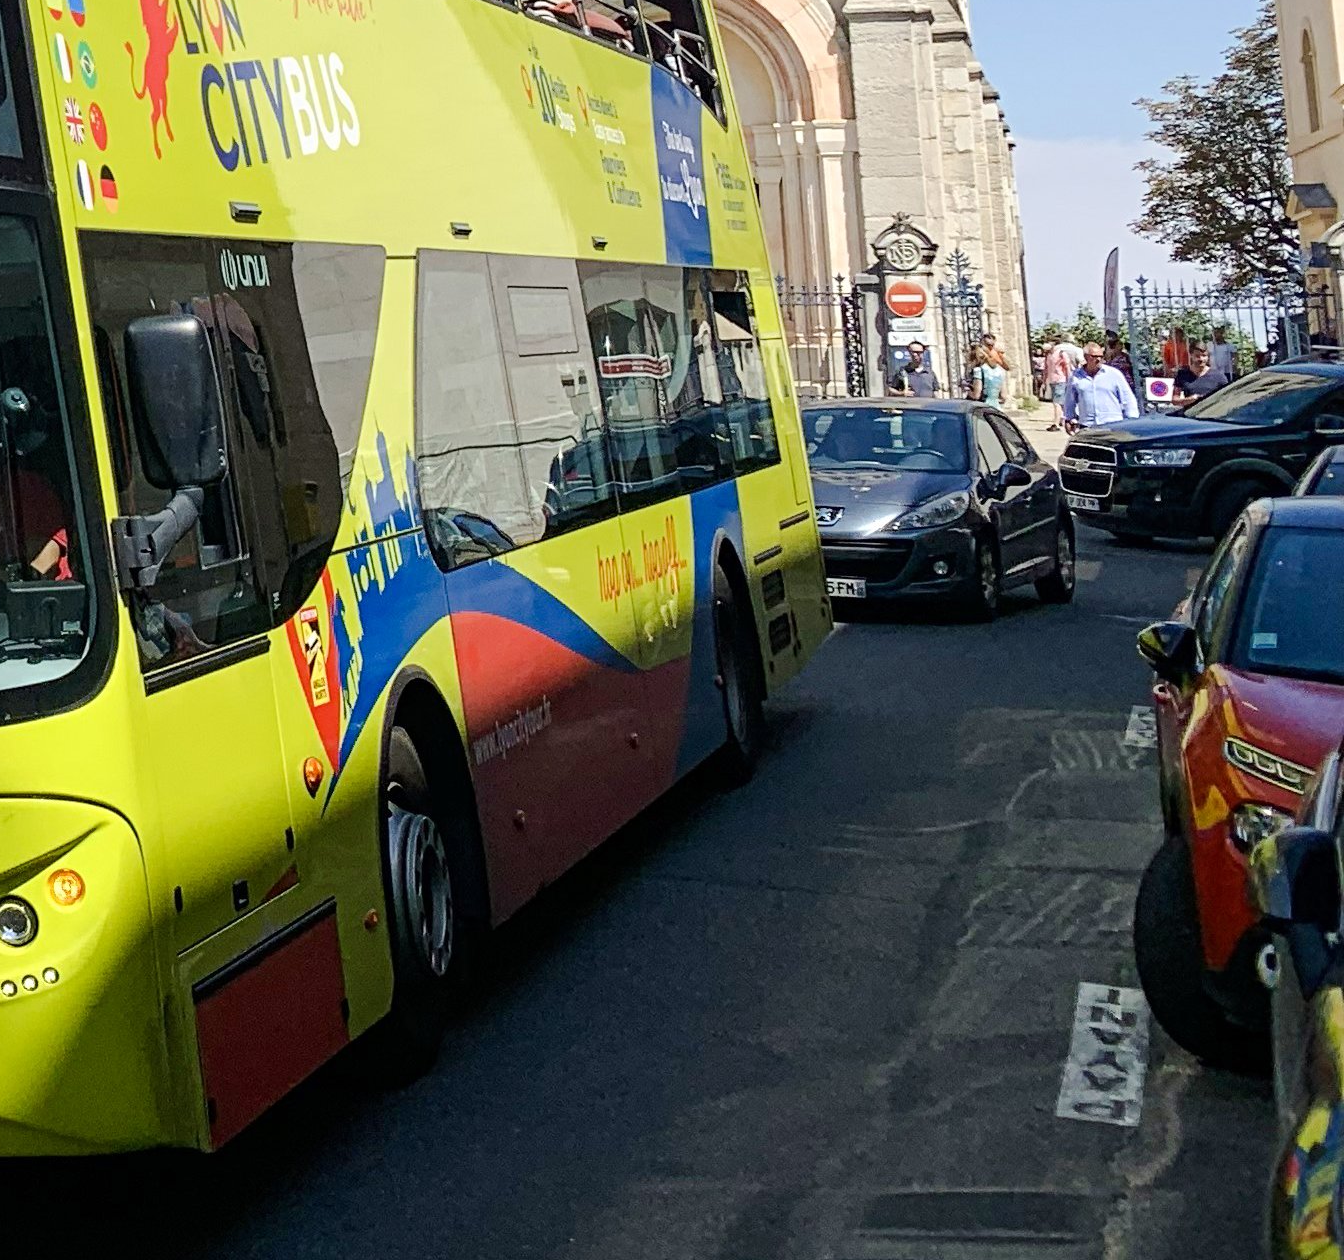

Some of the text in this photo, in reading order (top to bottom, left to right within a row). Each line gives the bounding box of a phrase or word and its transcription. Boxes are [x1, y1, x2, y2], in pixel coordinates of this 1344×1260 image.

[201, 51, 360, 171] CITYBUS
[531, 63, 556, 127] 10
[596, 545, 620, 612] hop
[641, 529, 662, 592] hop
